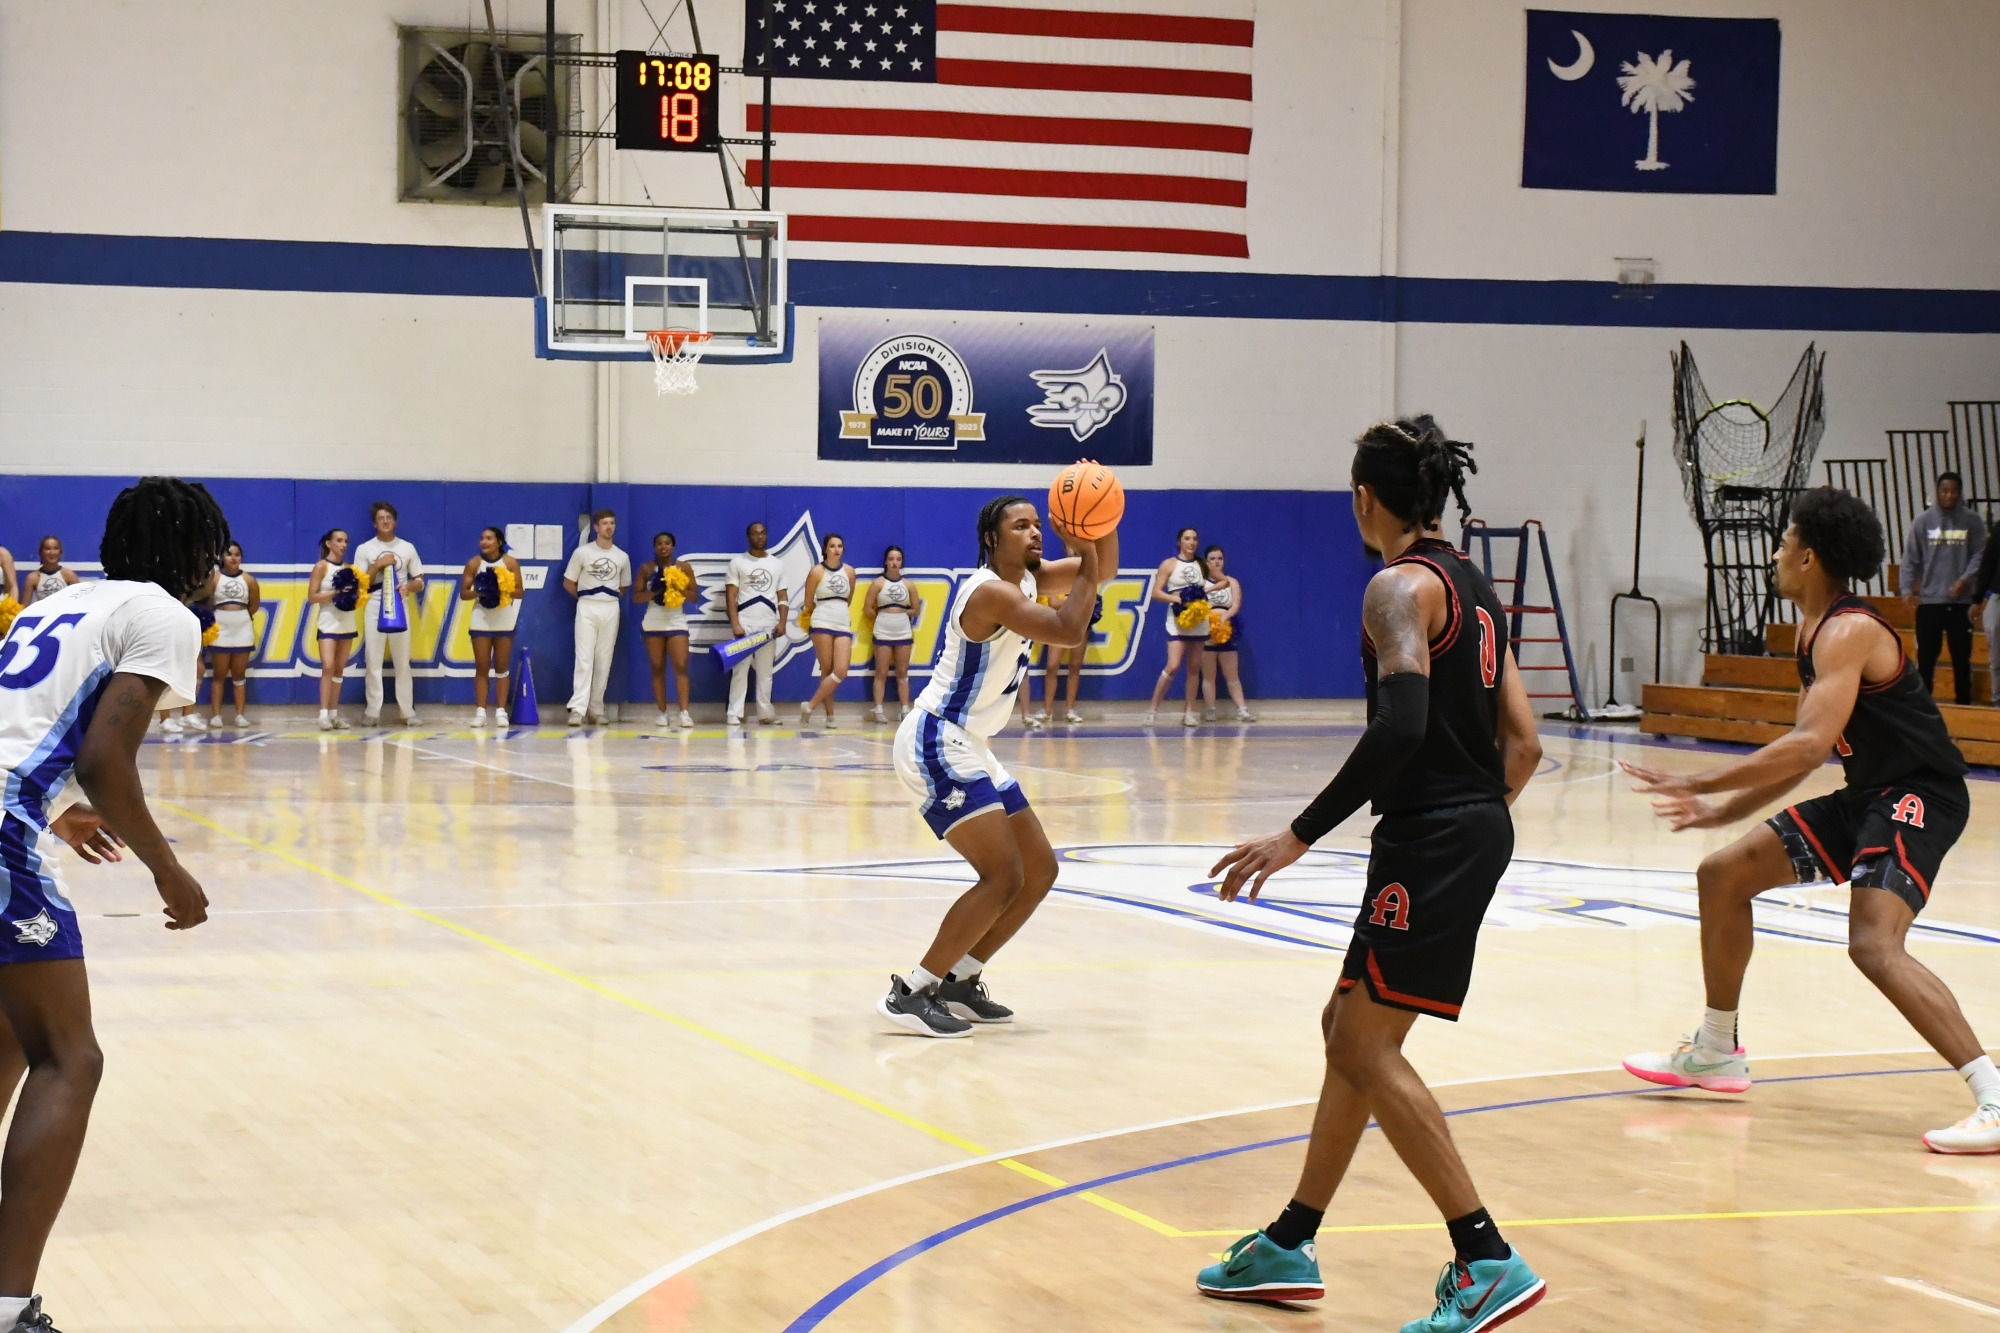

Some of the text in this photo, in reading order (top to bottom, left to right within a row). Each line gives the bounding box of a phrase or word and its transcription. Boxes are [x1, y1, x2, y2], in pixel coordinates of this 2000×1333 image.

[639, 60, 711, 91] 17:08
[661, 93, 698, 143] 18
[880, 341, 947, 362] DIVISION II
[898, 360, 928, 371] NCAA
[883, 374, 943, 419] 50
[848, 421, 867, 429] 1973
[876, 422, 950, 441] MAKE IT YOURS
[958, 423, 977, 431] 2023
[524, 573, 539, 581] TM
[1892, 793, 1925, 829] A
[1369, 882, 1410, 931] A
